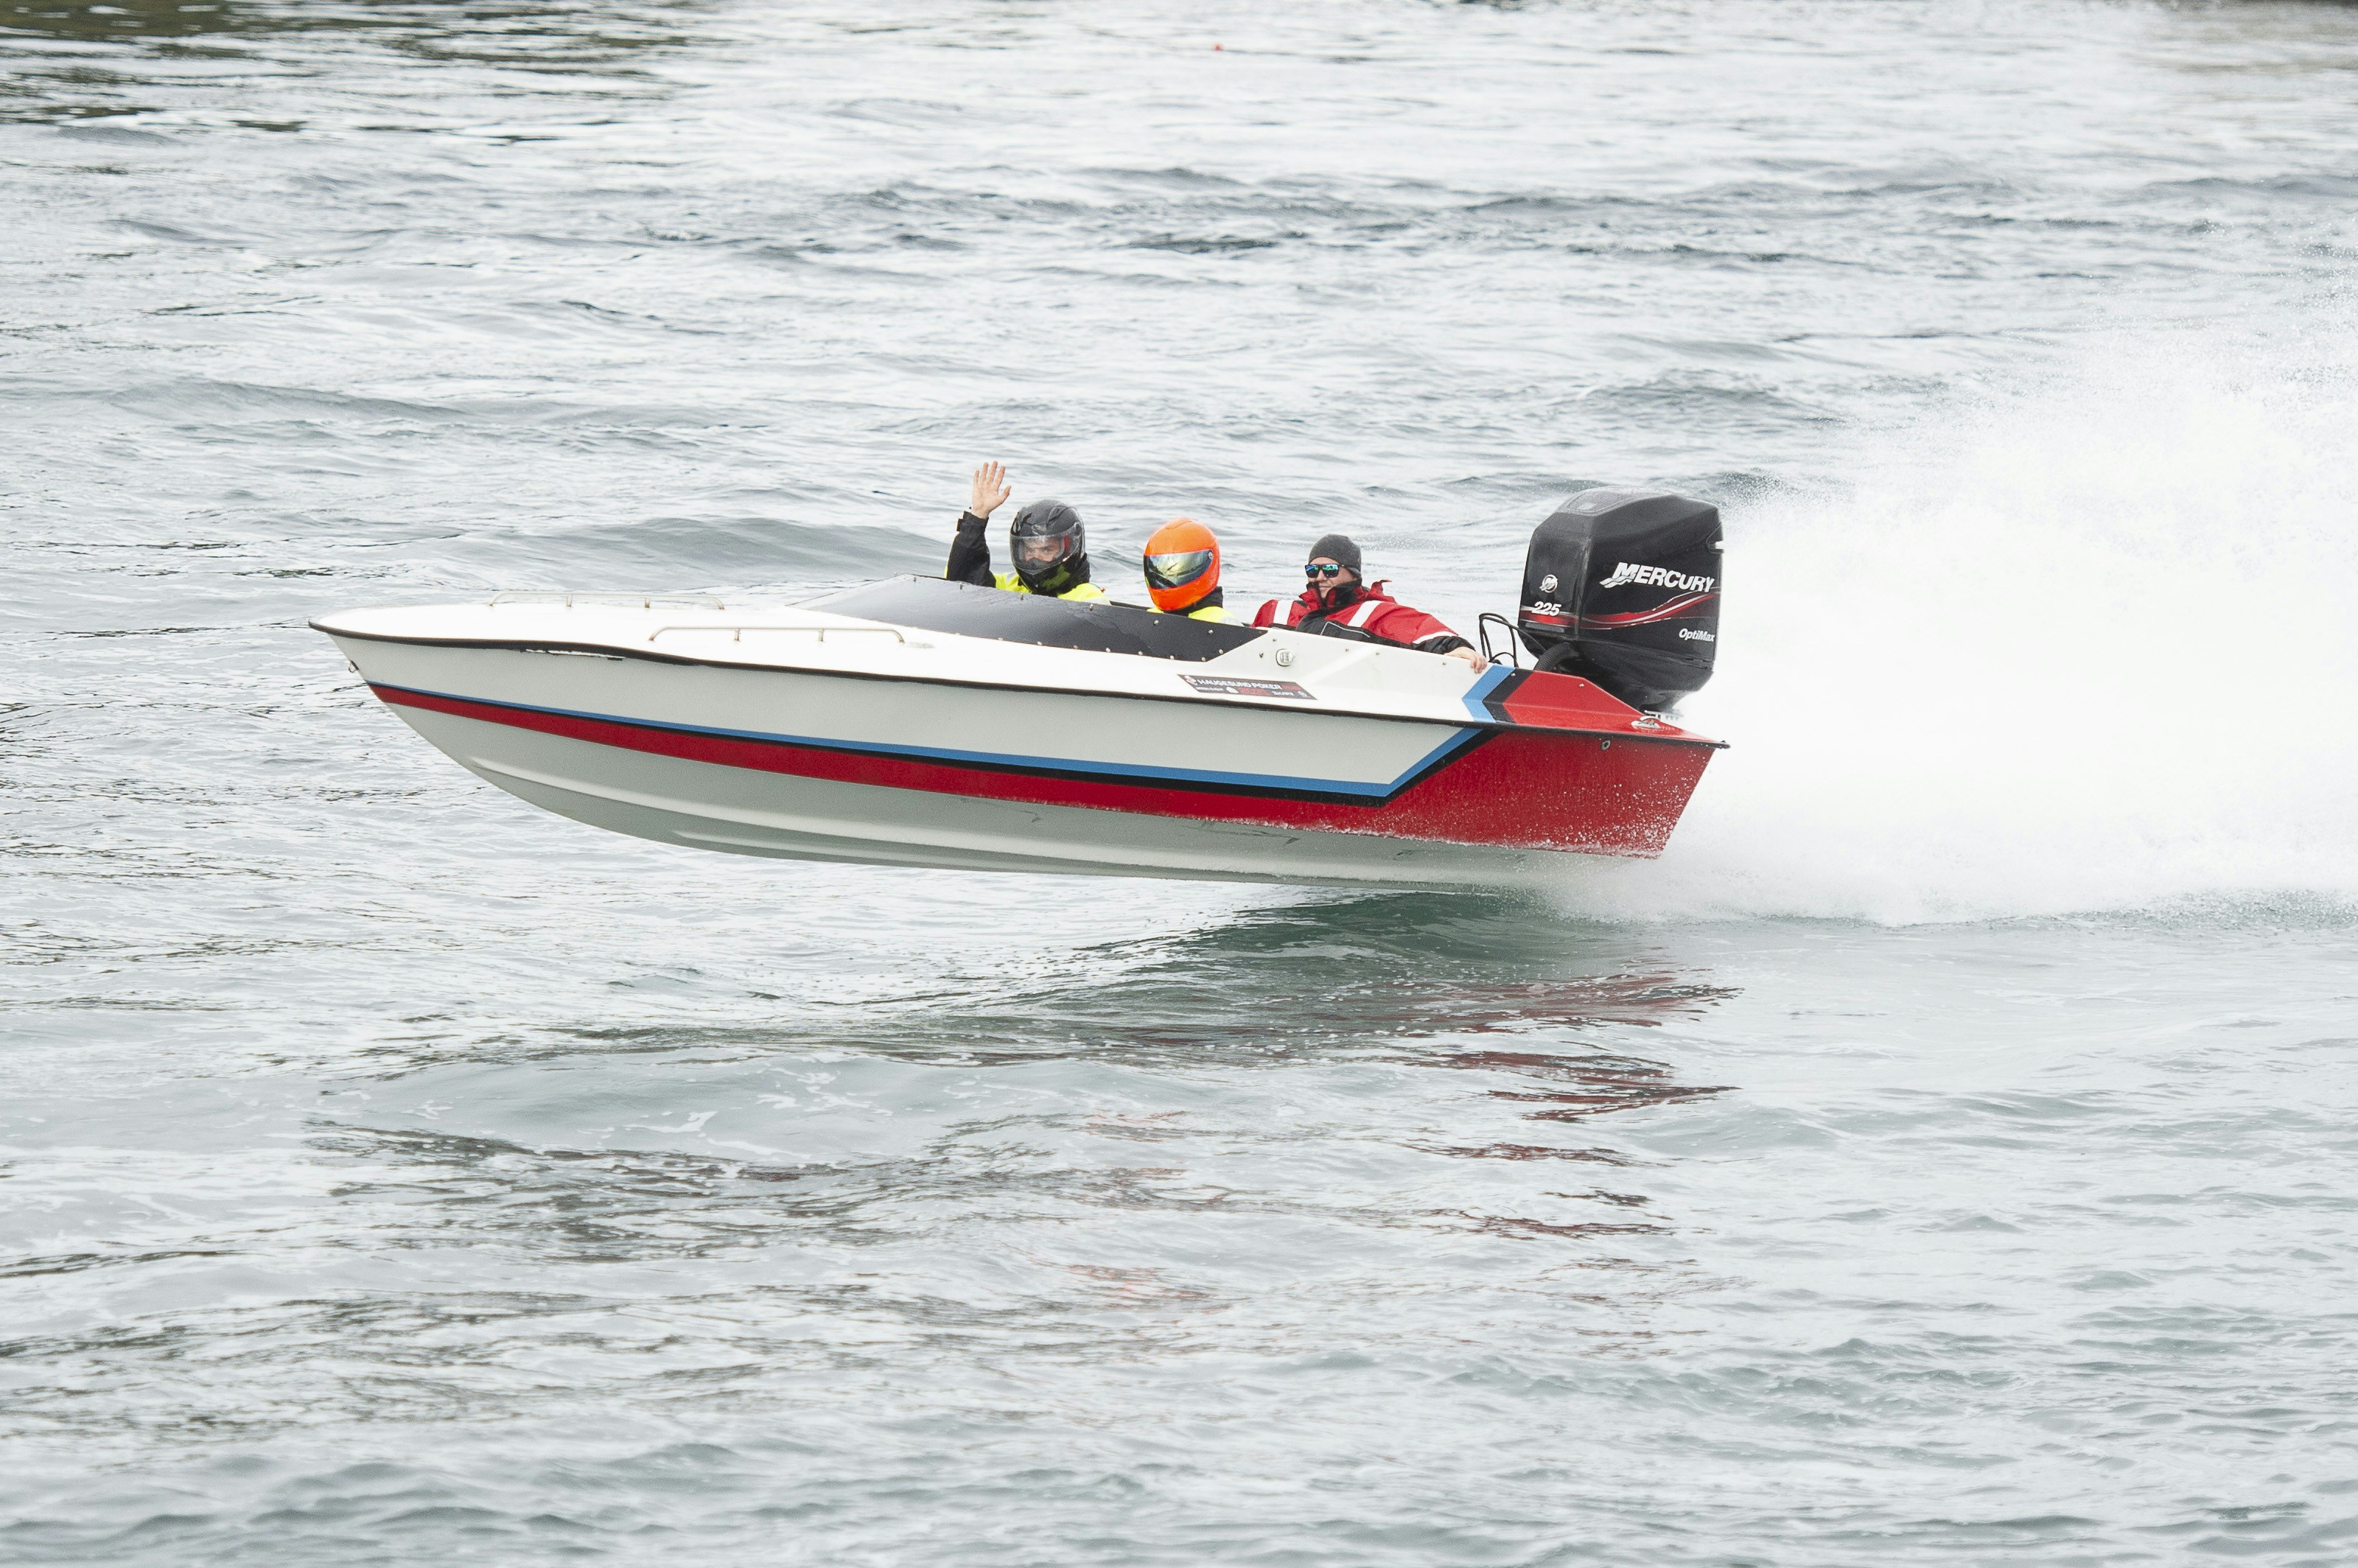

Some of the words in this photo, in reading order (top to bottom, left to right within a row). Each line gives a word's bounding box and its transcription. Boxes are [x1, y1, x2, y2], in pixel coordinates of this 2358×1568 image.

[1600, 562, 1715, 592] MERCURY
[1533, 601, 1561, 616] 225
[1679, 628, 1715, 643] OptiMax
